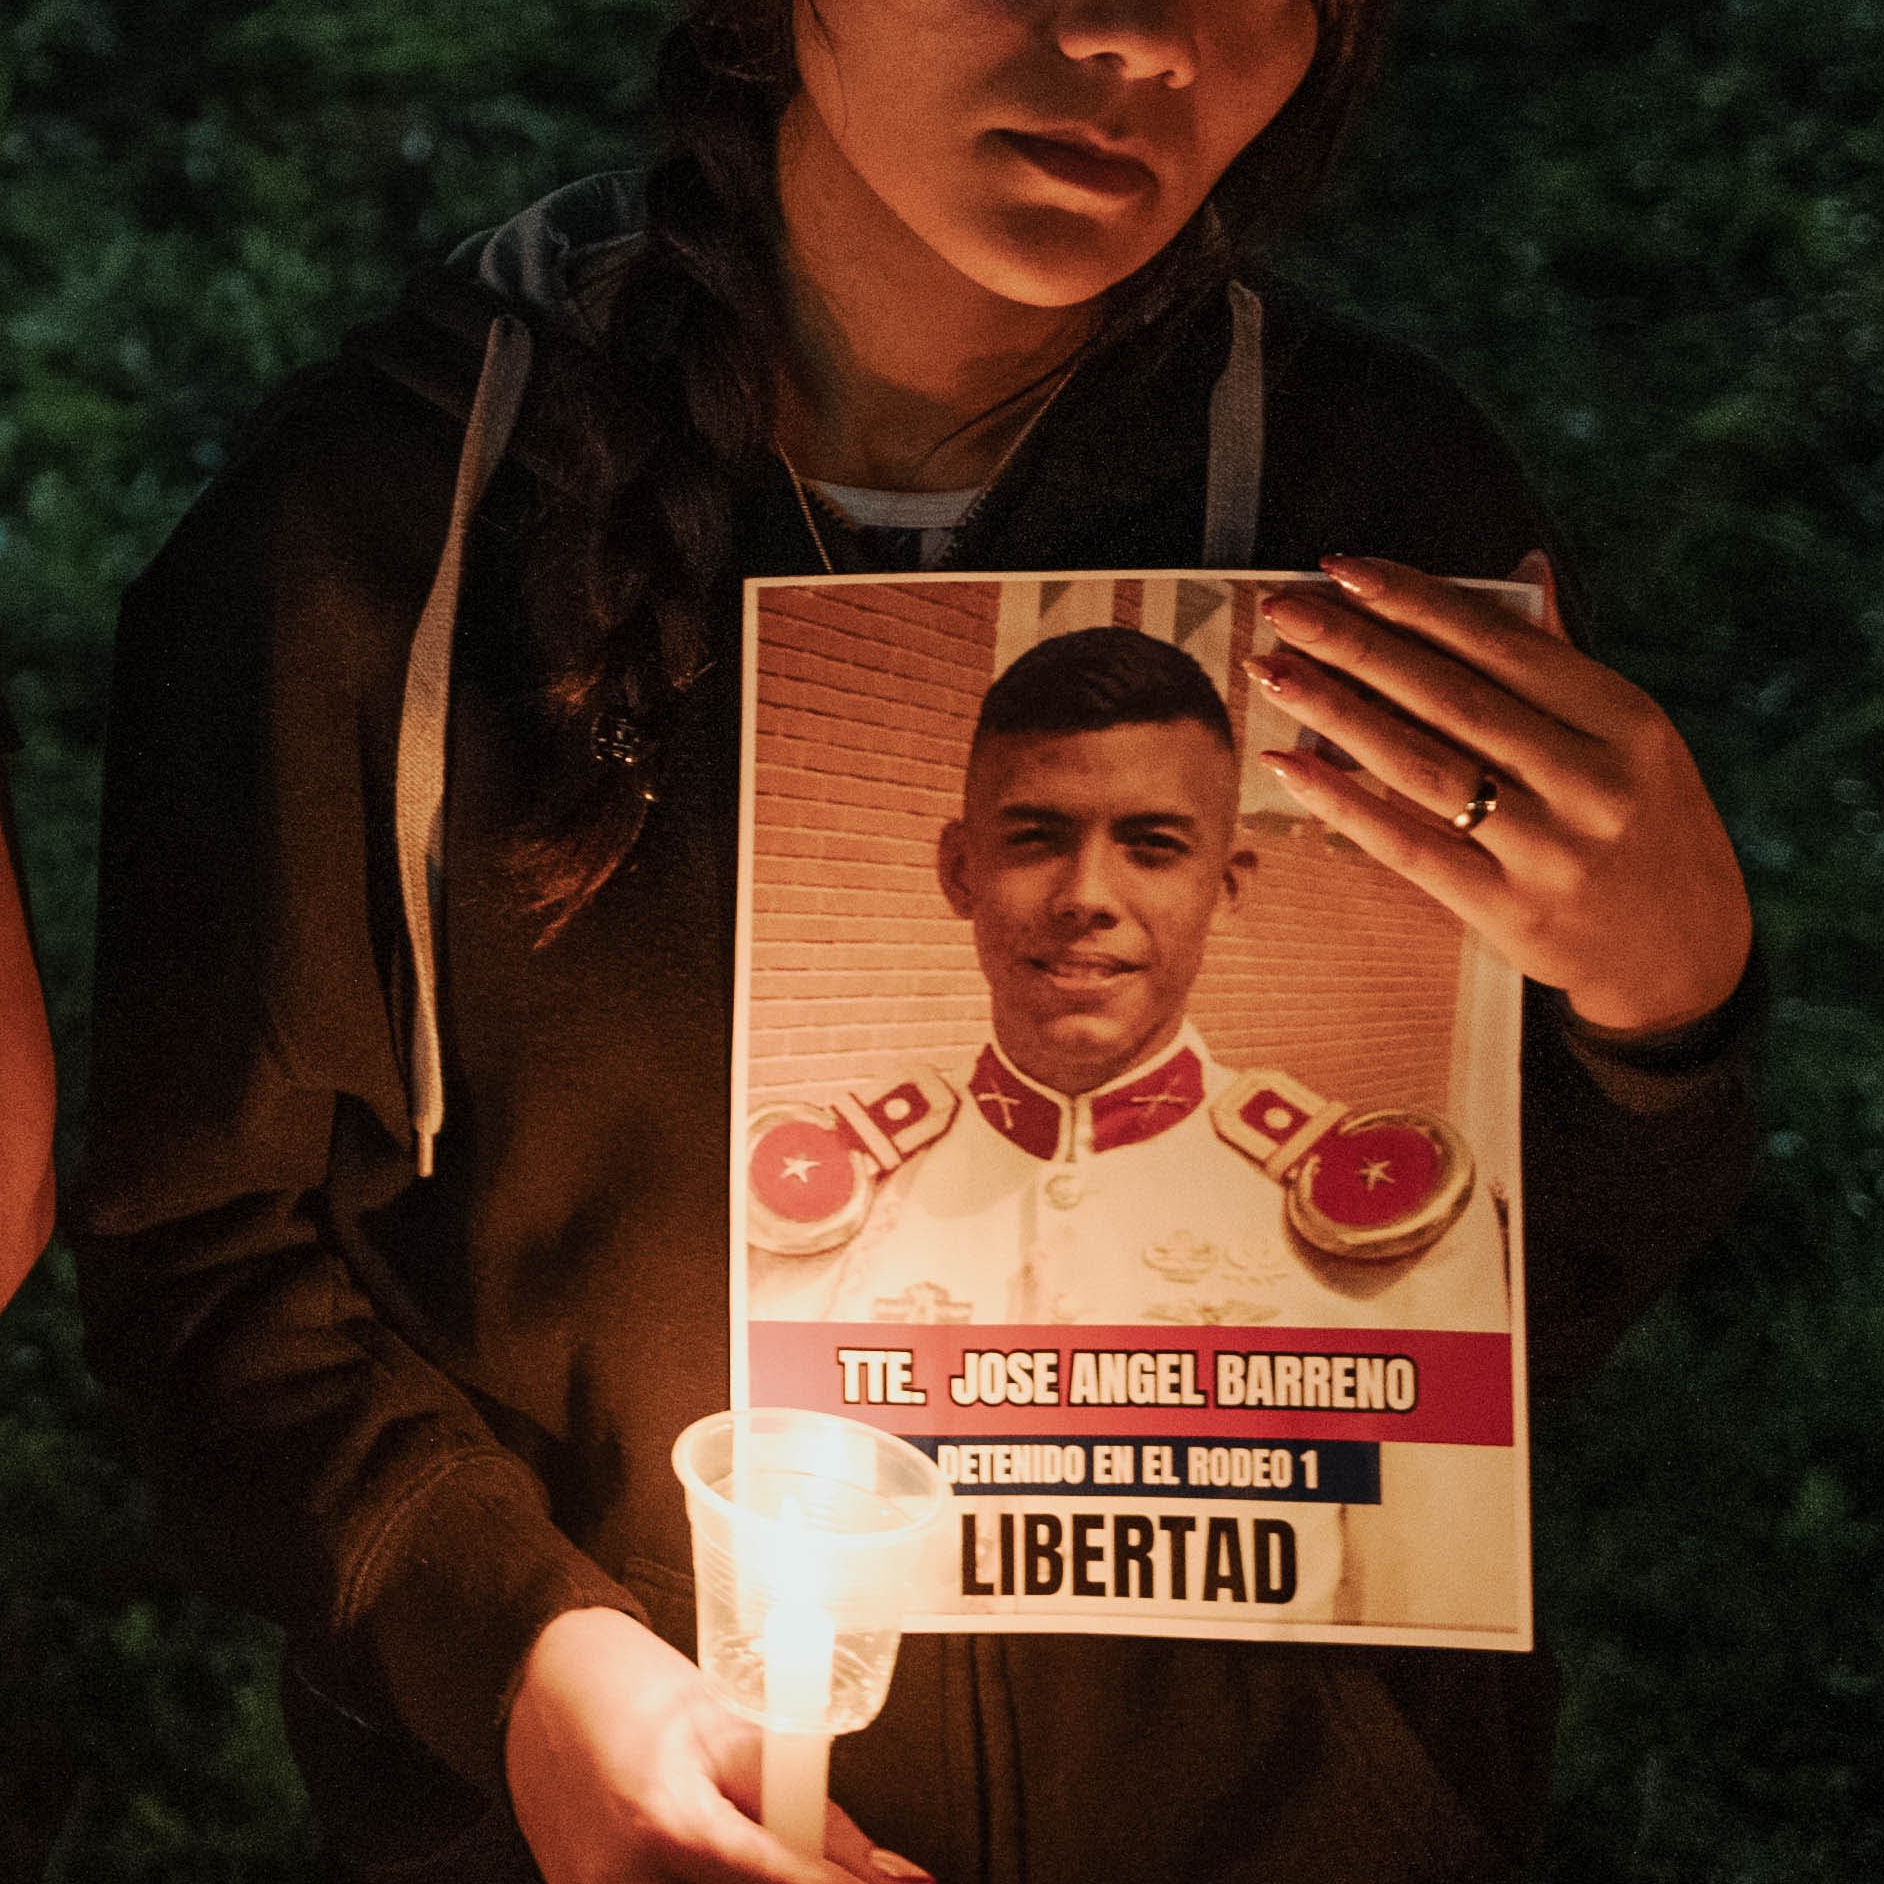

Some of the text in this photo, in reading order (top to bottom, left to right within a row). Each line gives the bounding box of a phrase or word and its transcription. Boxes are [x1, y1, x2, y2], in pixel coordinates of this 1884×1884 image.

[838, 1348, 1418, 1412] TTE. JOSE ANGEL BARRENO
[937, 1443, 1320, 1491] DETENIDO EN EL RODEO 1
[960, 1512, 1298, 1605] LIBERTAD
